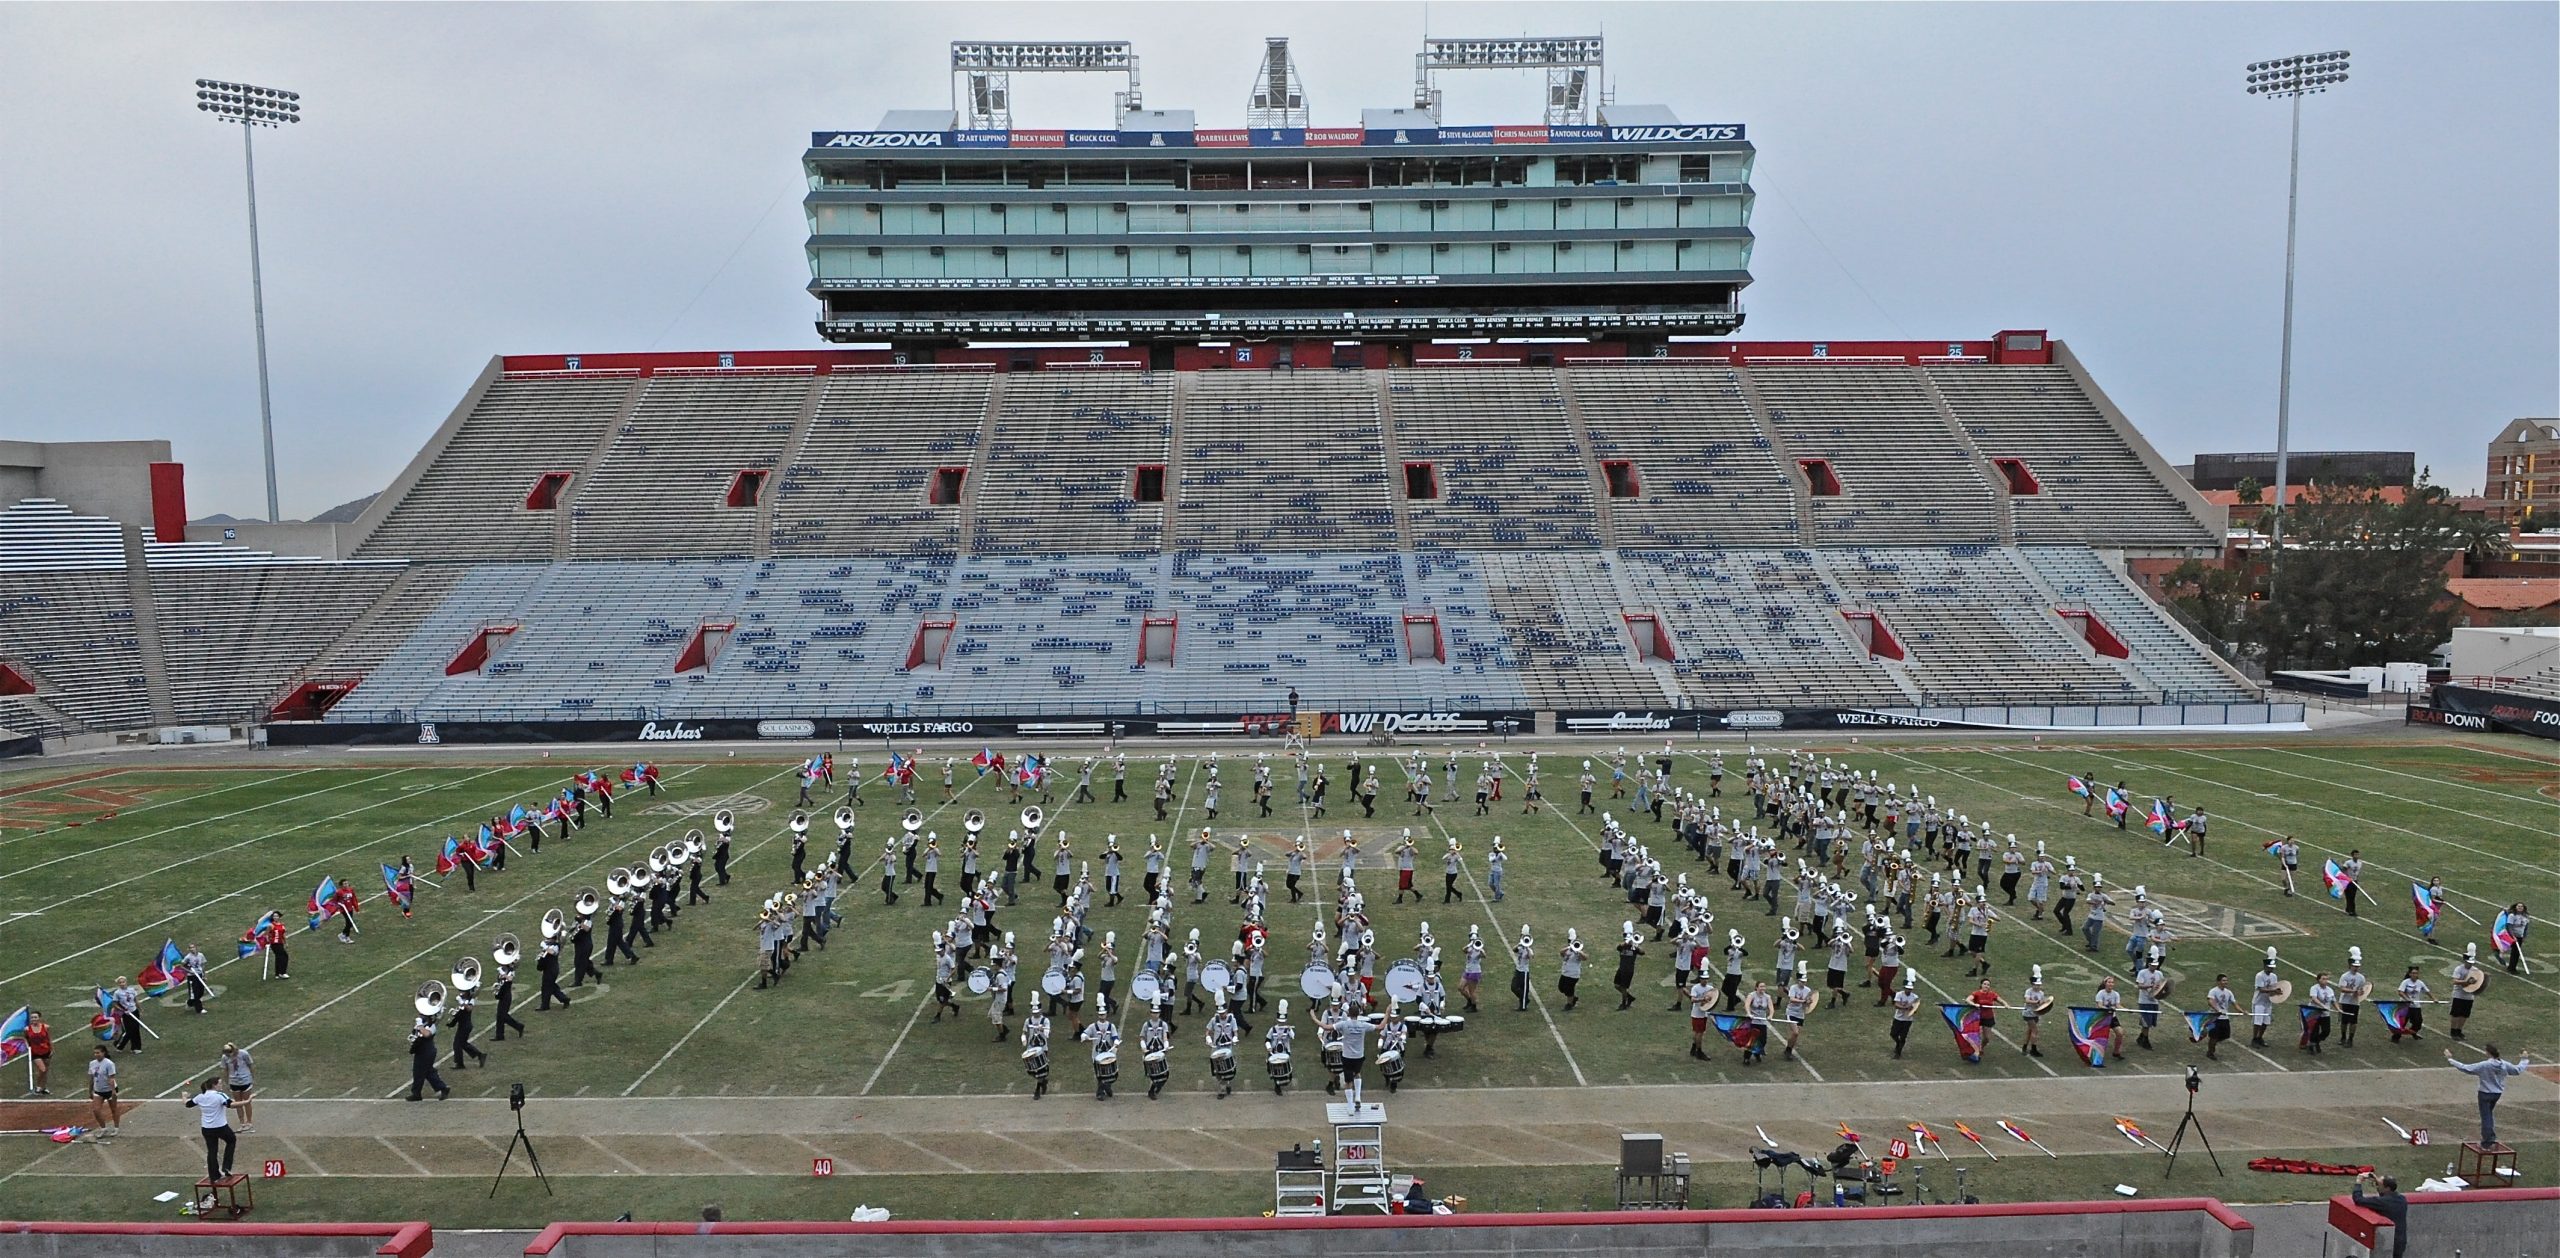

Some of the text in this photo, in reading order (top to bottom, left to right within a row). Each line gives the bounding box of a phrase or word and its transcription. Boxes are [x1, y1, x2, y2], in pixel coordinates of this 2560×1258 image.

[1195, 134, 1249, 142] 4 DARRYLL LEWIS
[1446, 131, 1461, 139] STEVE
[1611, 126, 1738, 140] WILDCATS
[826, 133, 942, 147] ARIZONA
[1090, 353, 1104, 362] 20
[1238, 352, 1250, 361] 21
[1459, 350, 1472, 359] 22
[1654, 349, 1668, 358] 23
[1814, 349, 1827, 357] 24
[1949, 348, 1962, 357] 25
[720, 358, 733, 367] 18
[894, 356, 906, 364] 19
[568, 361, 578, 370] 17
[224, 529, 235, 538] 16
[1837, 713, 1888, 724] WELLS
[2412, 708, 2485, 729] BEAR DOWN
[2490, 705, 2560, 726] ARIZONA FOO
[638, 721, 704, 740] Bashas'
[870, 722, 973, 733] WELLS FARGO
[2414, 1130, 2428, 1145] 30
[1349, 1146, 1364, 1159] 50
[1891, 1140, 1906, 1157] 40
[265, 1161, 281, 1177] 30
[815, 1160, 831, 1175] 40
